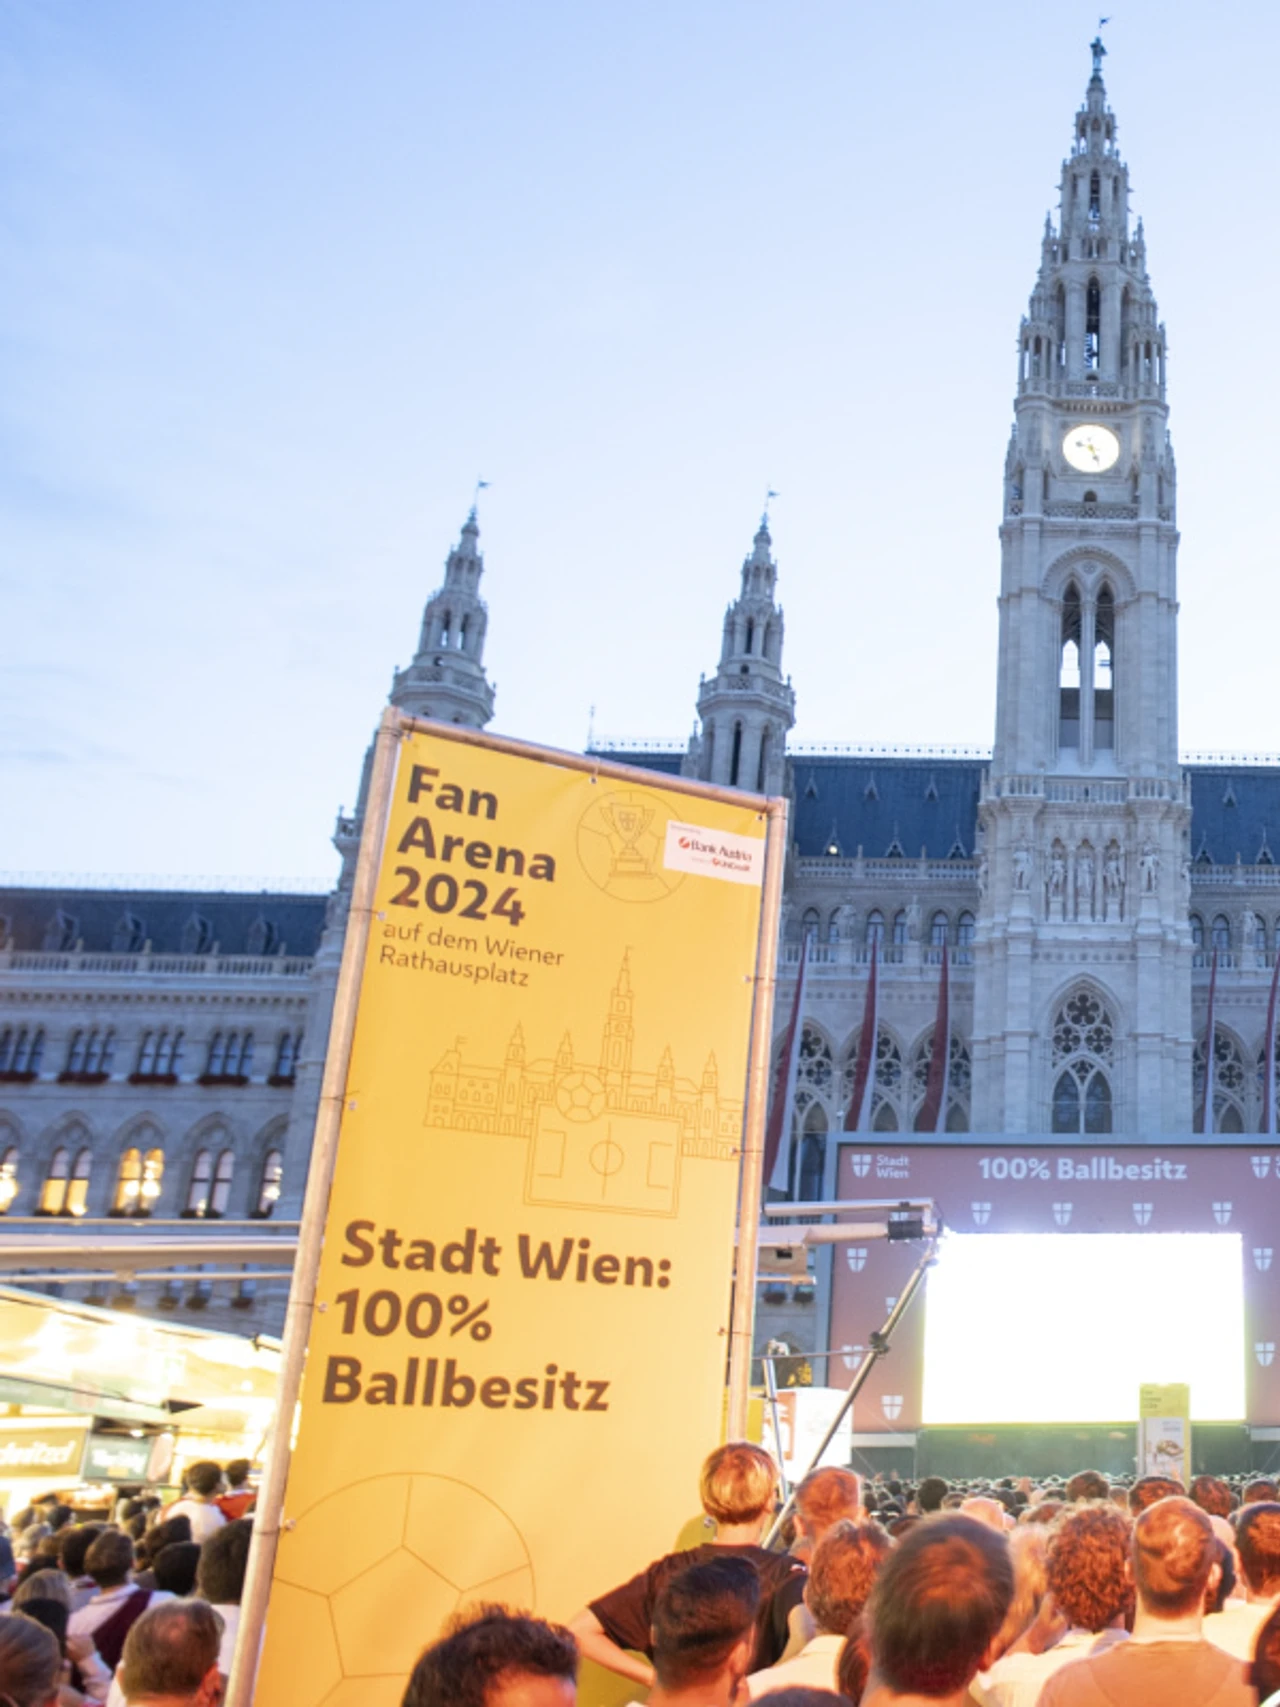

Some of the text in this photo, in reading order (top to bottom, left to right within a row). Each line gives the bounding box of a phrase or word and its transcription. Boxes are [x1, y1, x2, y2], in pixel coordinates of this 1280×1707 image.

[407, 764, 498, 821] Fan
[397, 815, 556, 883] Arena
[388, 866, 526, 927] 2024
[379, 944, 530, 987] Rathausplatz
[382, 921, 565, 967] auf dem Wiener
[876, 1154, 909, 1167] Stadt
[876, 1167, 909, 1179] Wien
[978, 1156, 1187, 1181] 100% Ballbesitz
[341, 1219, 672, 1289] Stadt Wien:
[334, 1287, 493, 1342] 100%
[321, 1354, 611, 1412] Ballbesitz
